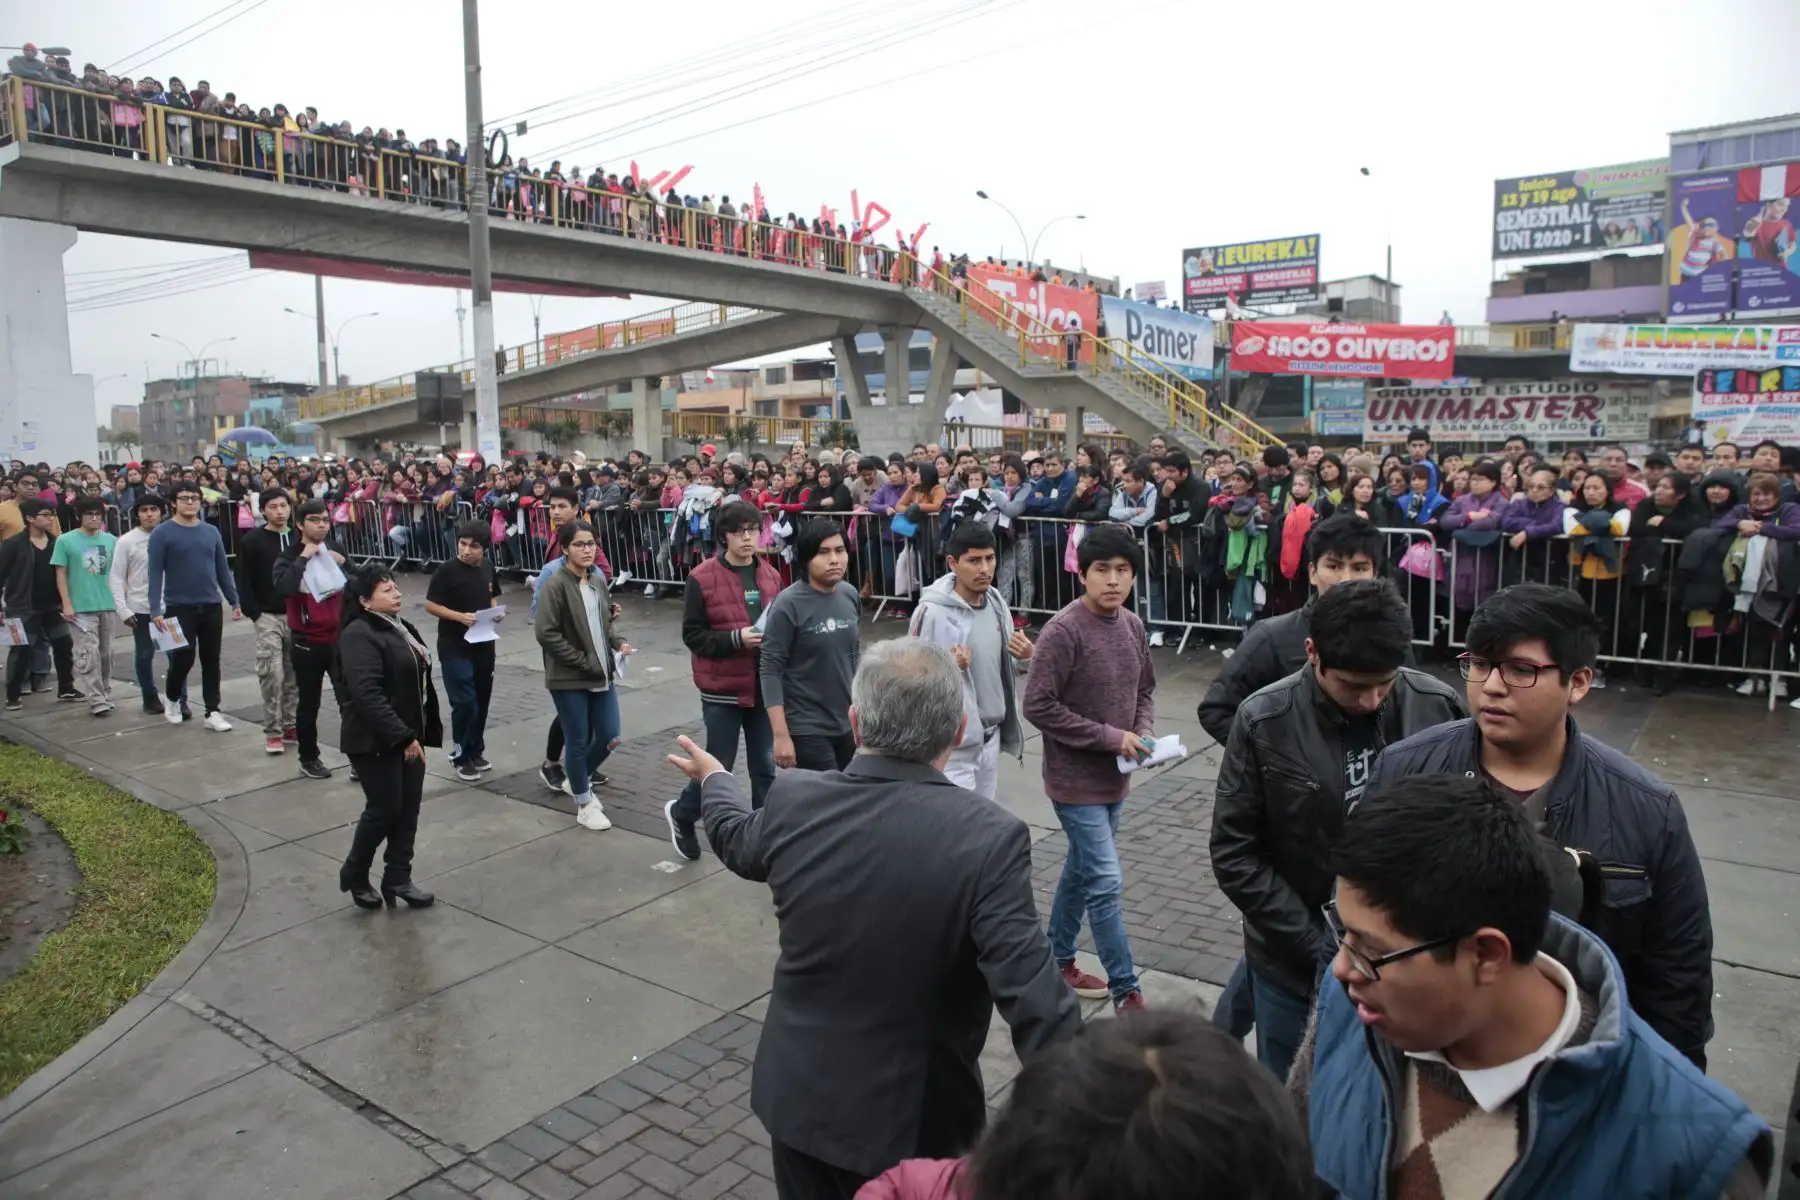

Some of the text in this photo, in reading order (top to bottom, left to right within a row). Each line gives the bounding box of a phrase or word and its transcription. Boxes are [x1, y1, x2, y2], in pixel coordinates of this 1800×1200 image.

[1518, 177, 1557, 192] Inicio
[1551, 187, 1577, 203] ago
[1496, 202, 1593, 231] SEMESTRAL
[1217, 236, 1317, 266] ¡EUREKA!
[1498, 230, 1531, 252] UNI
[1533, 228, 1573, 248] 2020
[1125, 308, 1198, 362] Pamer
[1268, 335, 1330, 358] SACO
[1335, 337, 1450, 362] OLIVEROS
[1377, 387, 1452, 398] GRUPO
[1460, 386, 1487, 396] DE
[1495, 383, 1599, 396] ESTUDIO
[1368, 395, 1602, 421] UNIMASTER
[1472, 423, 1526, 431] MARCOS
